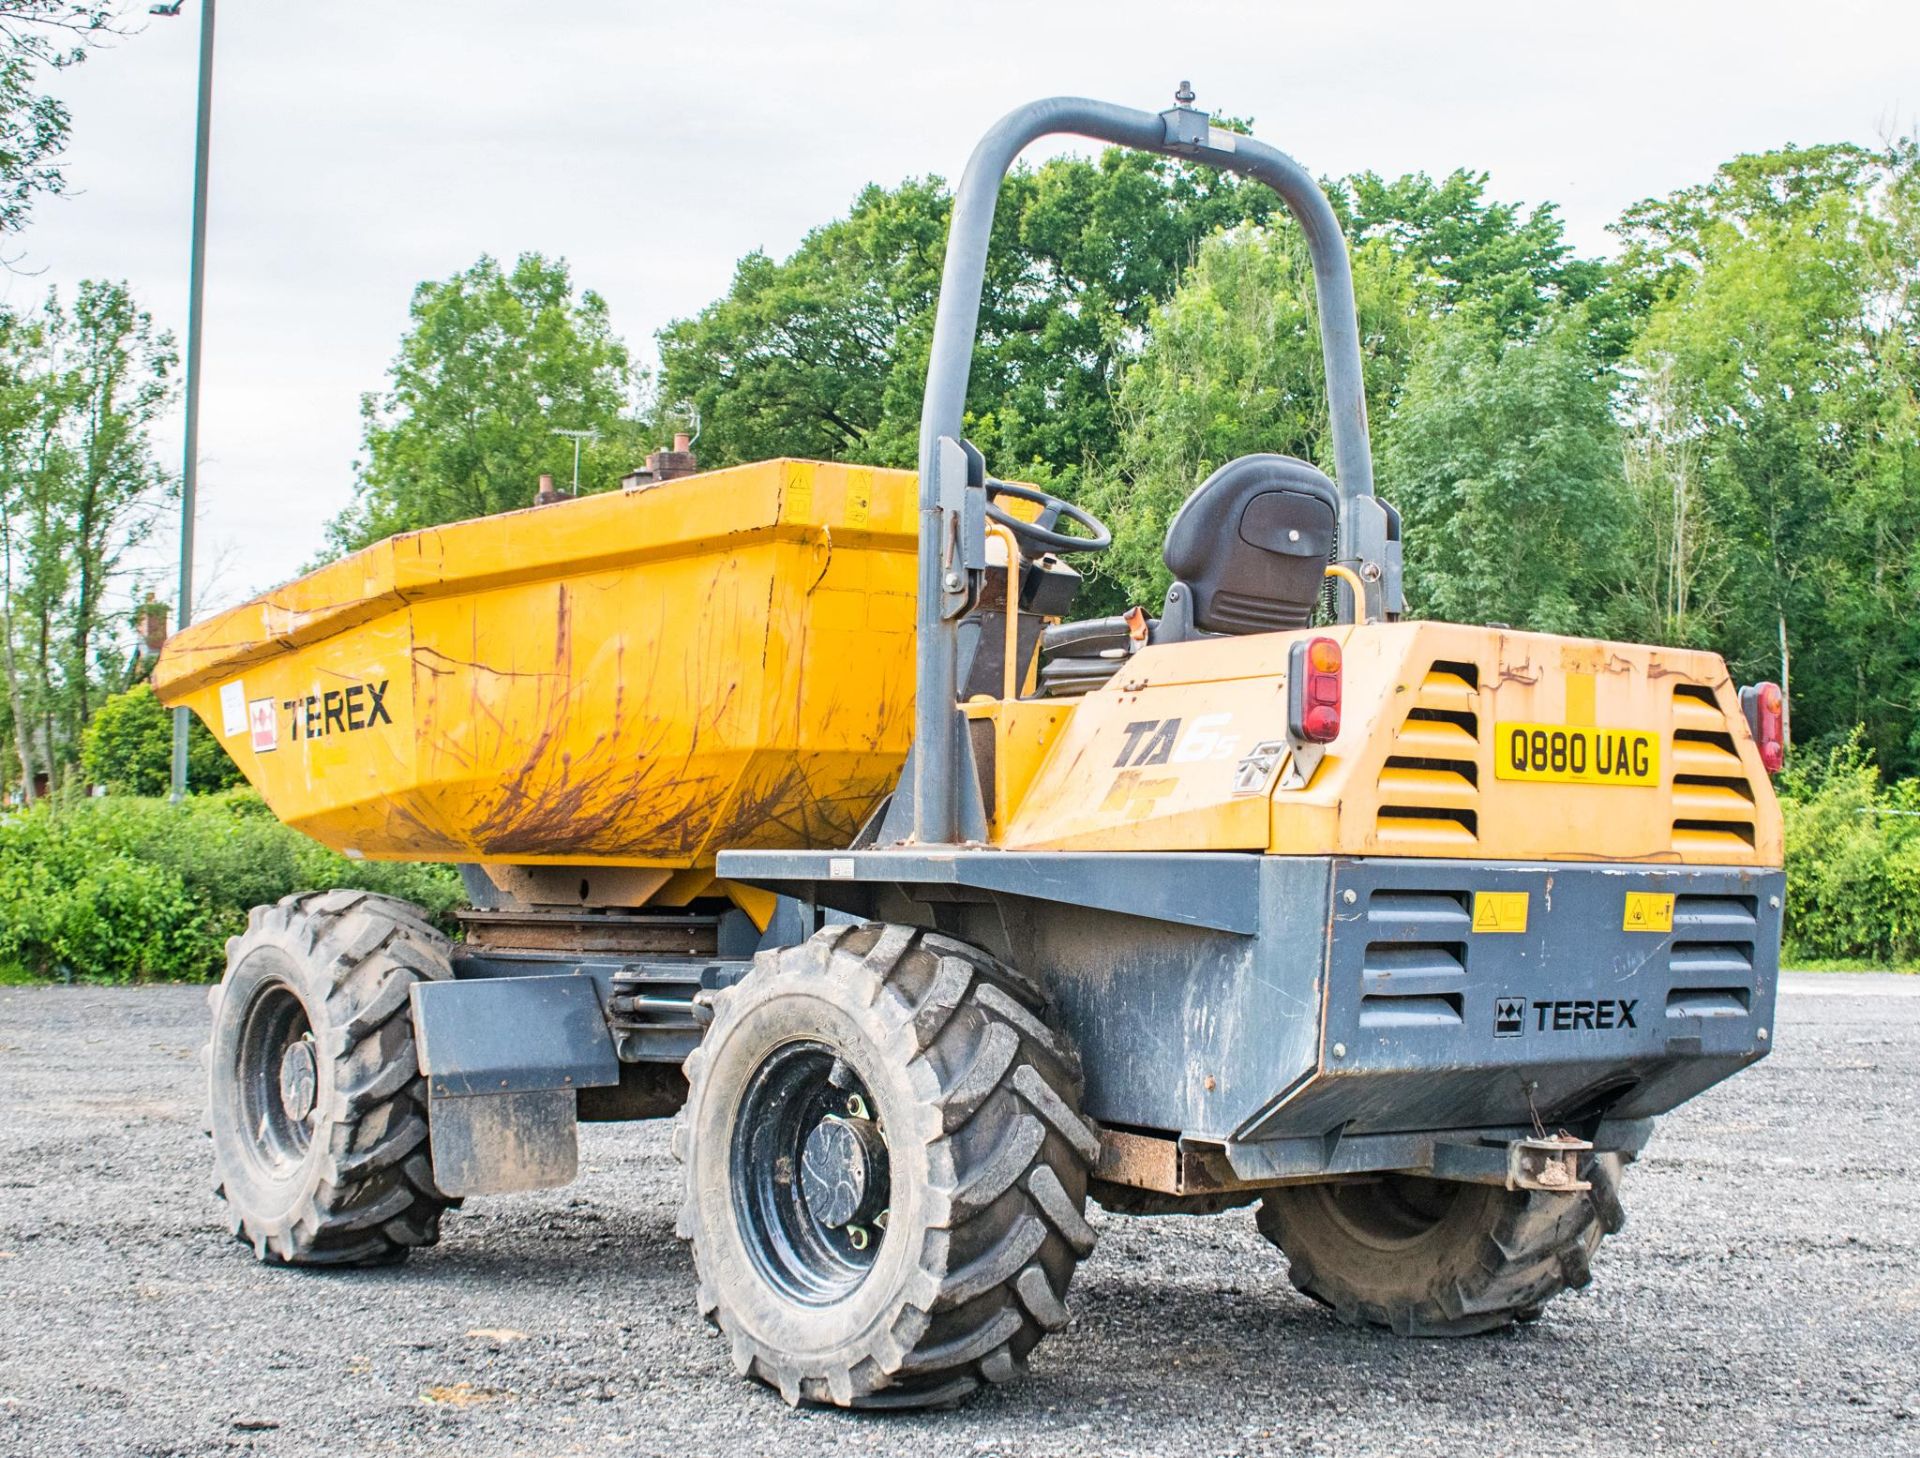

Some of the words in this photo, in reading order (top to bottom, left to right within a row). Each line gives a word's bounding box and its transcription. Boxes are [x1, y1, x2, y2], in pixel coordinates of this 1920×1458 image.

[283, 680, 393, 741] TEREX
[1511, 729, 1586, 773] Q880
[1596, 735, 1649, 777] UAG
[1532, 999, 1640, 1032] TEREX
